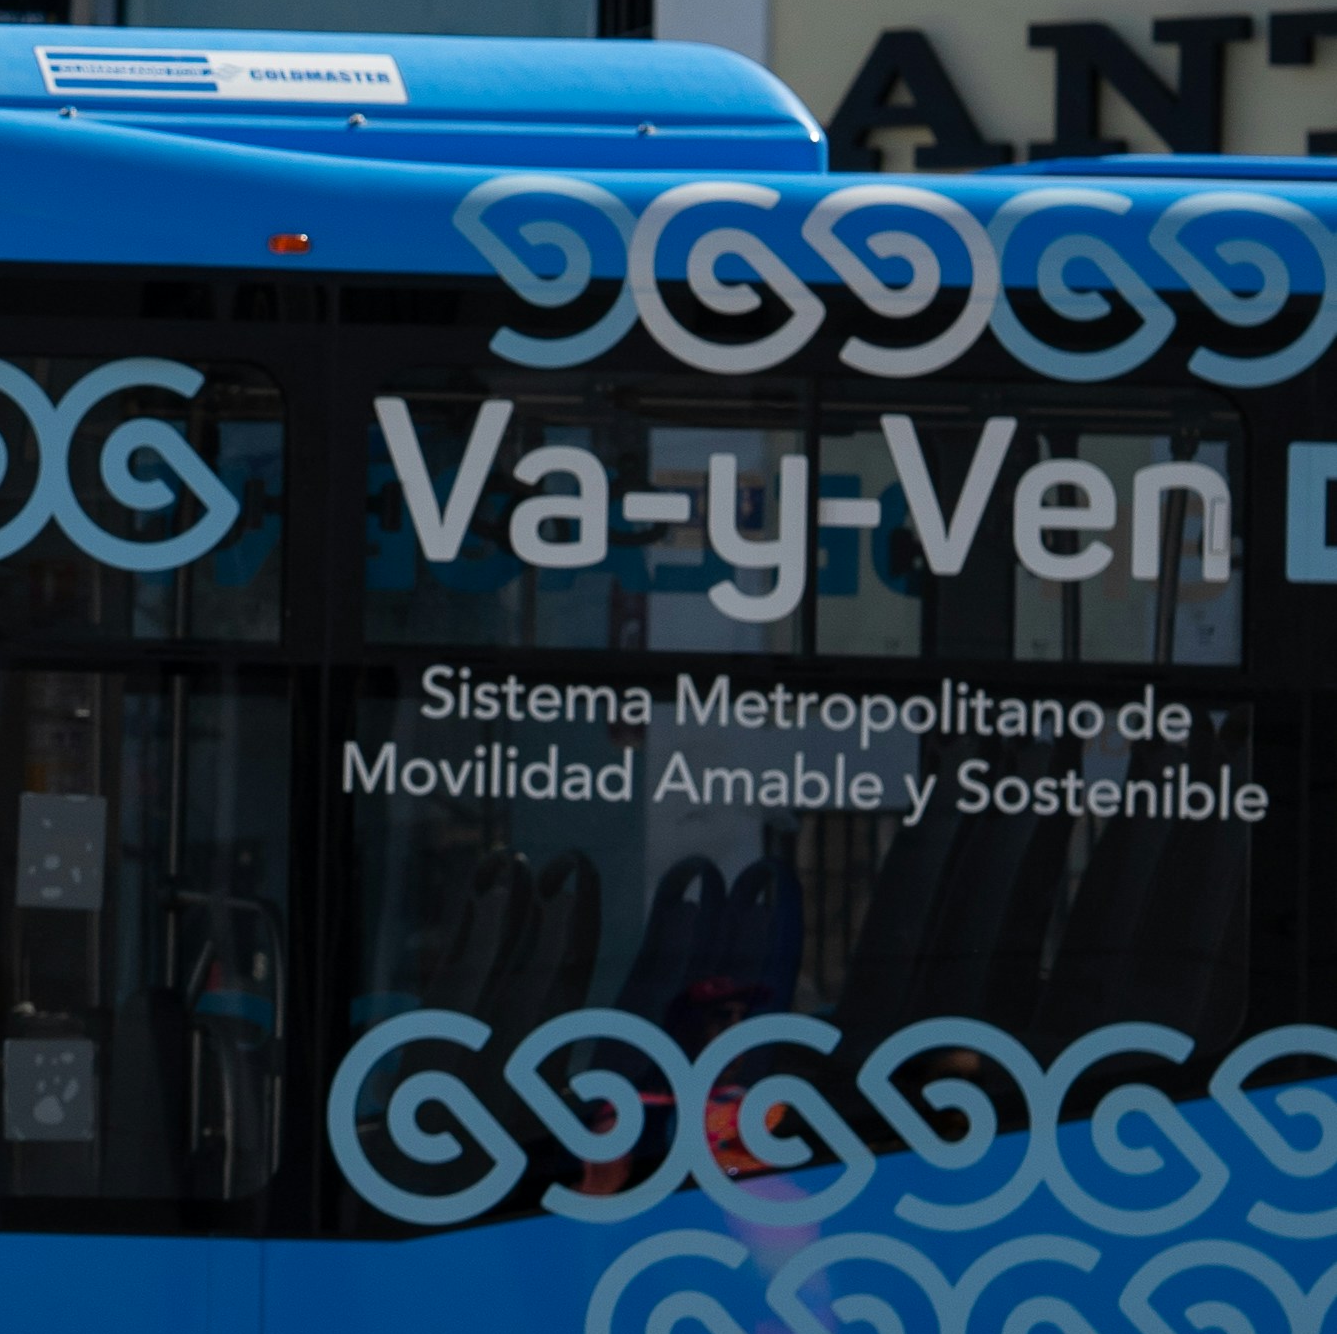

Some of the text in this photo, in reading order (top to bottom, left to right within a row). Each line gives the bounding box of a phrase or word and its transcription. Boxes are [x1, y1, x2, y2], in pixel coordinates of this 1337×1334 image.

[249, 67, 392, 85] COLDMASTER
[374, 396, 1232, 624] Va-y-Ven
[420, 666, 1193, 748] Sistema Metropolitano de
[342, 741, 1270, 825] Movilidad Amable y Sostenible
